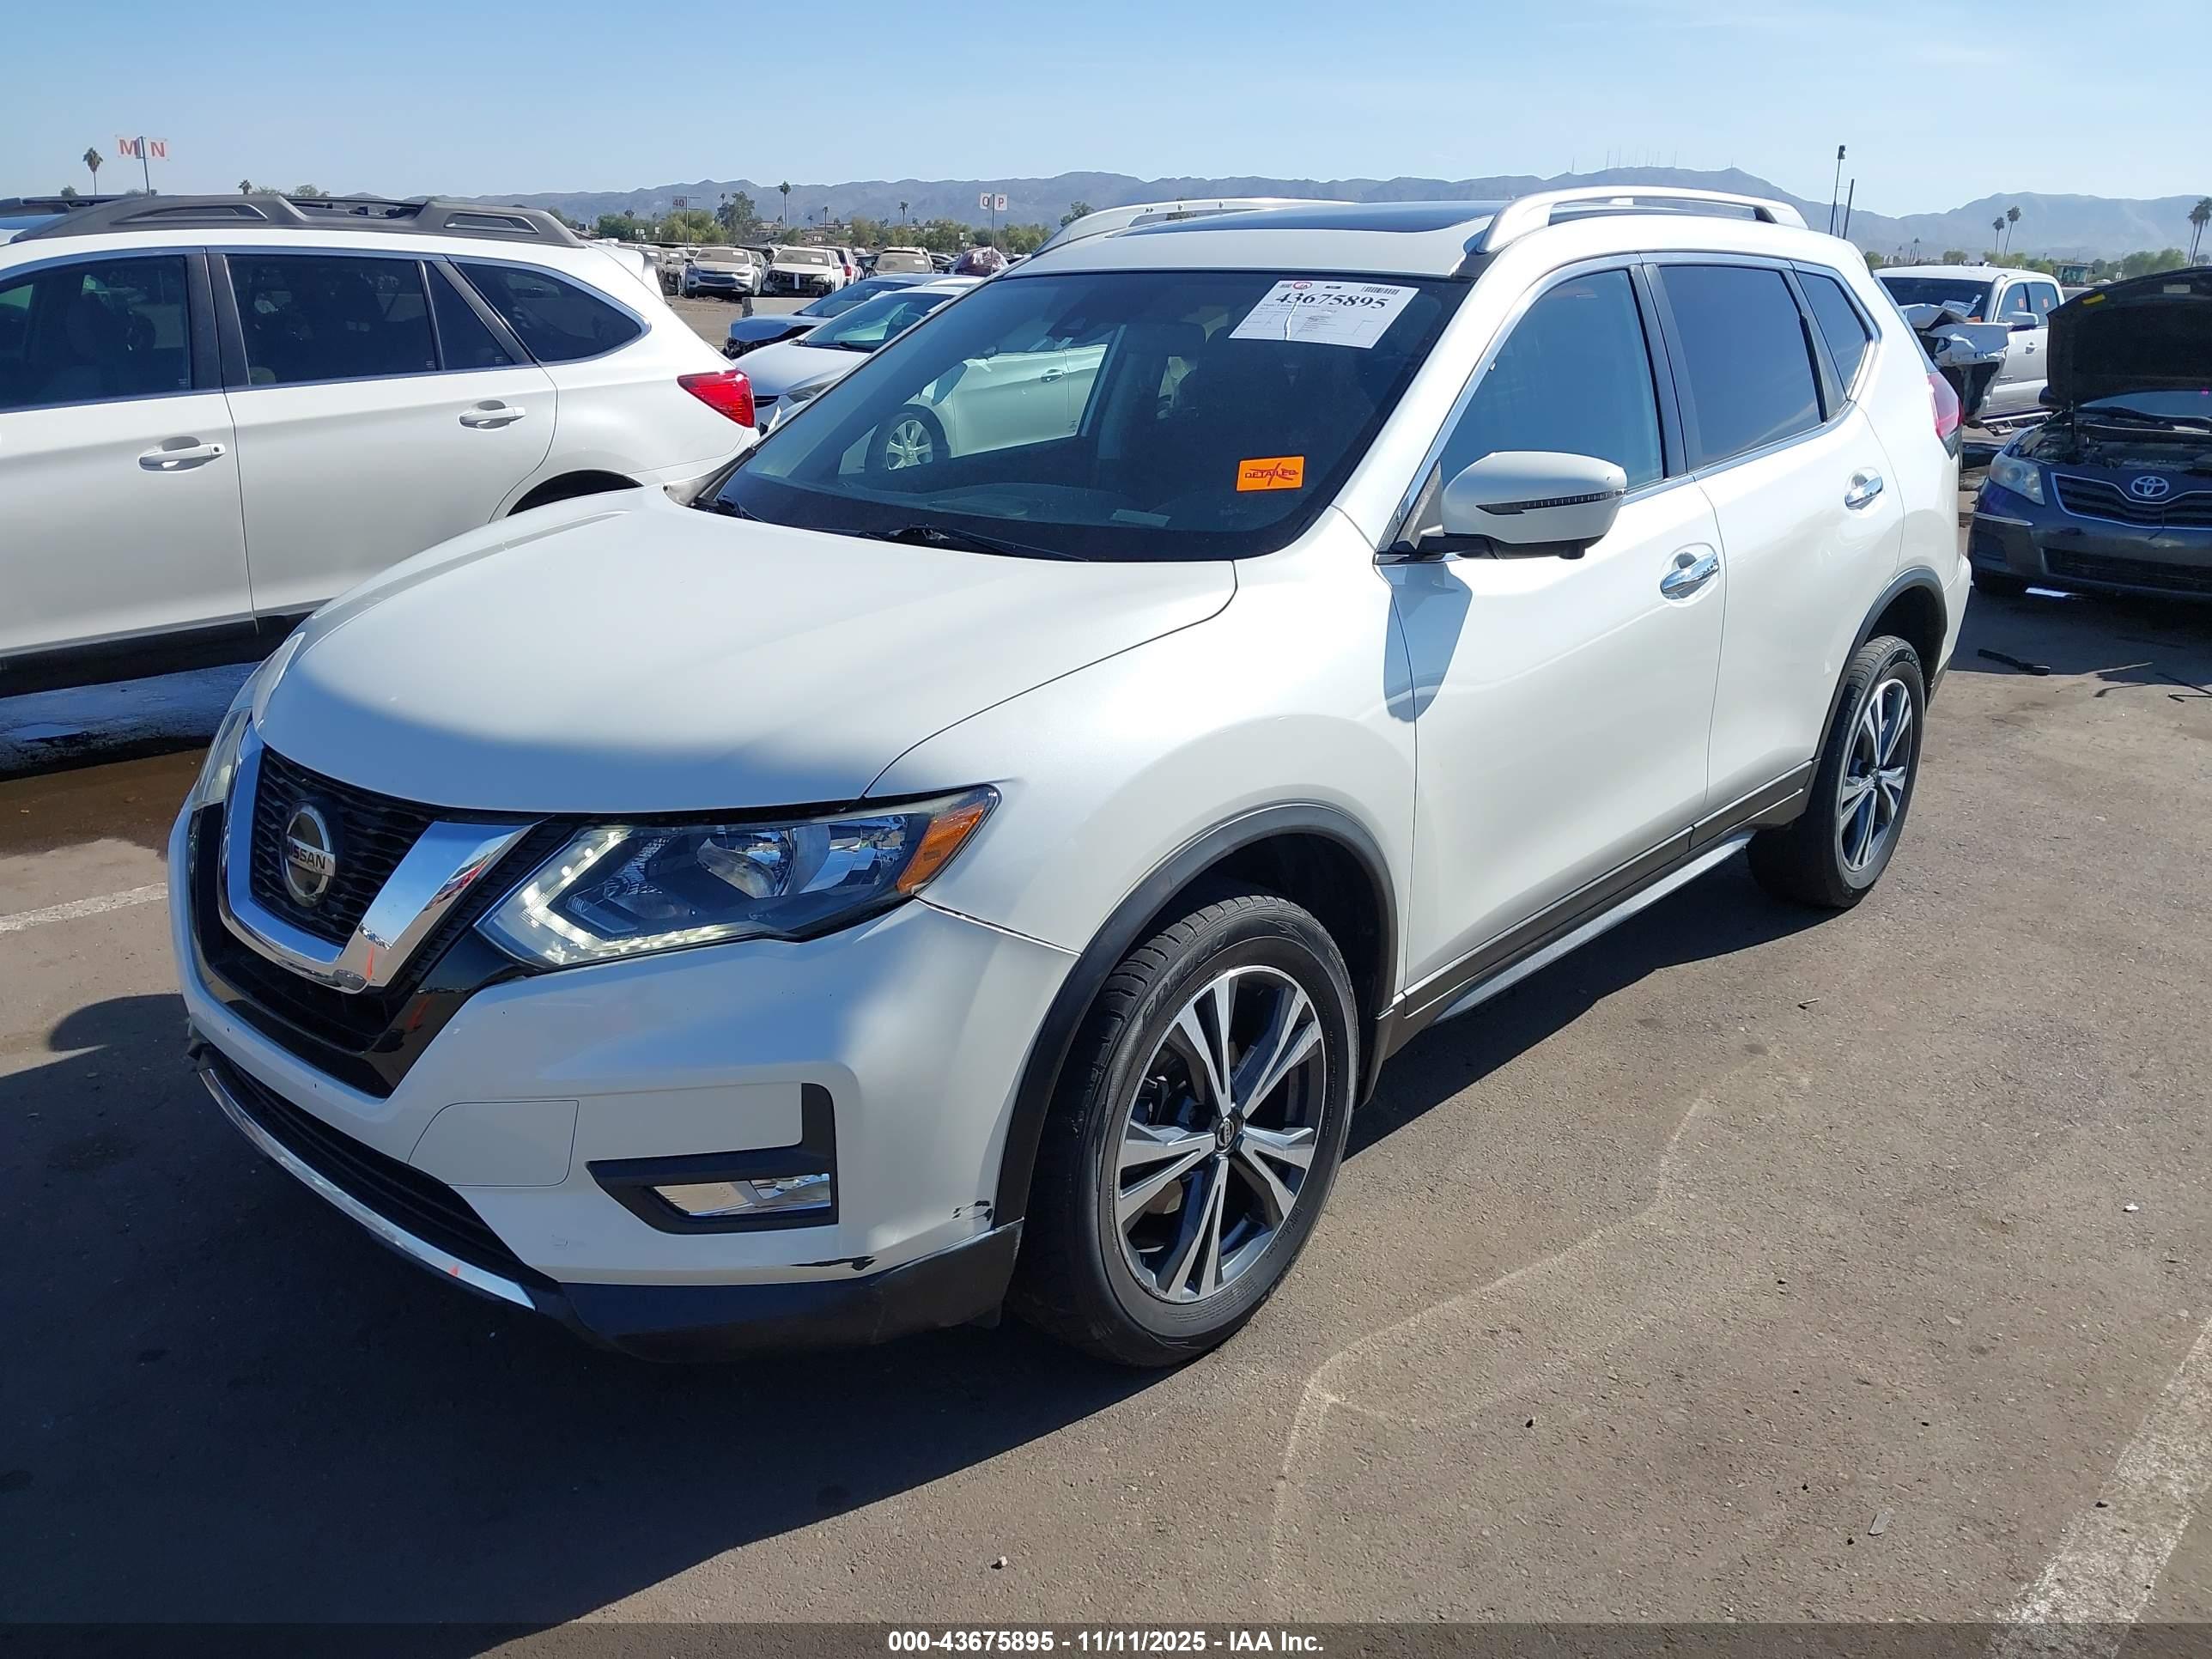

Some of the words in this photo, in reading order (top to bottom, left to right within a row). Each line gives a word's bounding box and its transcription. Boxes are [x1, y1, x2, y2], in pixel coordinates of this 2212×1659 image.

[118, 139, 138, 156] M
[150, 142, 165, 158] N
[672, 198, 684, 207] 40
[998, 197, 1005, 208] P
[1274, 291, 1390, 311] 43675895
[1244, 468, 1297, 479] DETAILED
[288, 842, 326, 870] NISSAN
